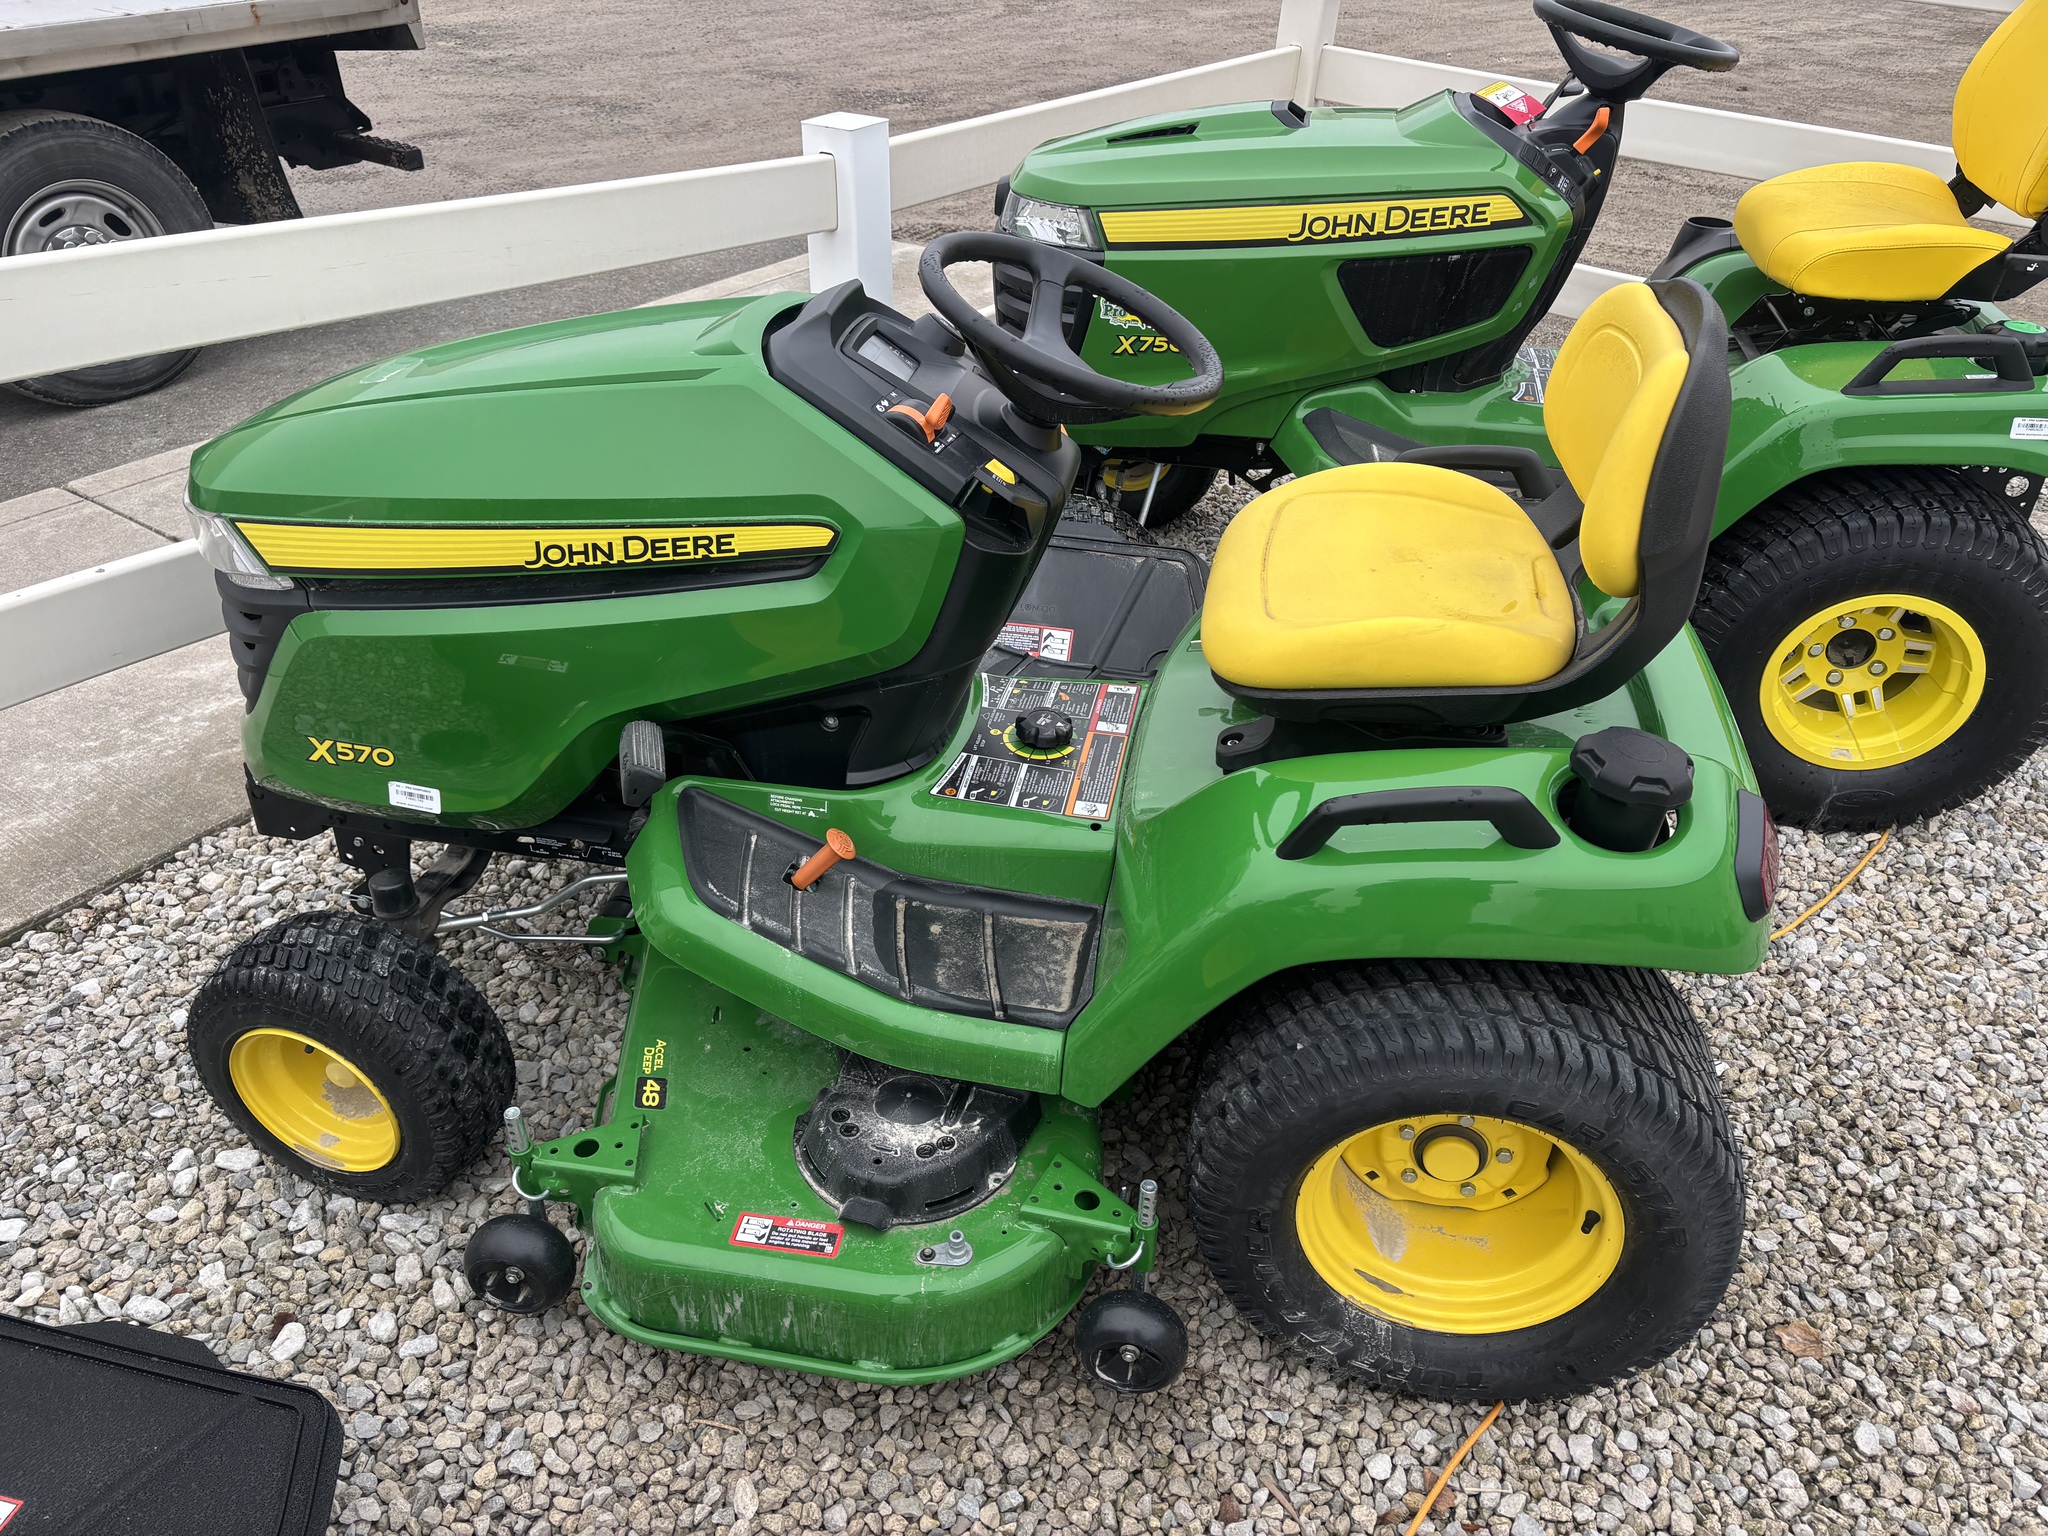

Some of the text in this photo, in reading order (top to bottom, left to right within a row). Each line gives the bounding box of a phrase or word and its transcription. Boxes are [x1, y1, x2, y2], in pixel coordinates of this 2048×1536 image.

[1288, 202, 1491, 239] JOHN DEERE
[525, 533, 736, 566] JOHN DEERE
[305, 735, 396, 767] X570
[642, 1047, 655, 1075] DEEP
[653, 1038, 667, 1071] ACCEL
[641, 1079, 660, 1107] 48
[778, 1227, 828, 1238] ROTATING BLADE
[795, 1221, 826, 1230] DANGER
